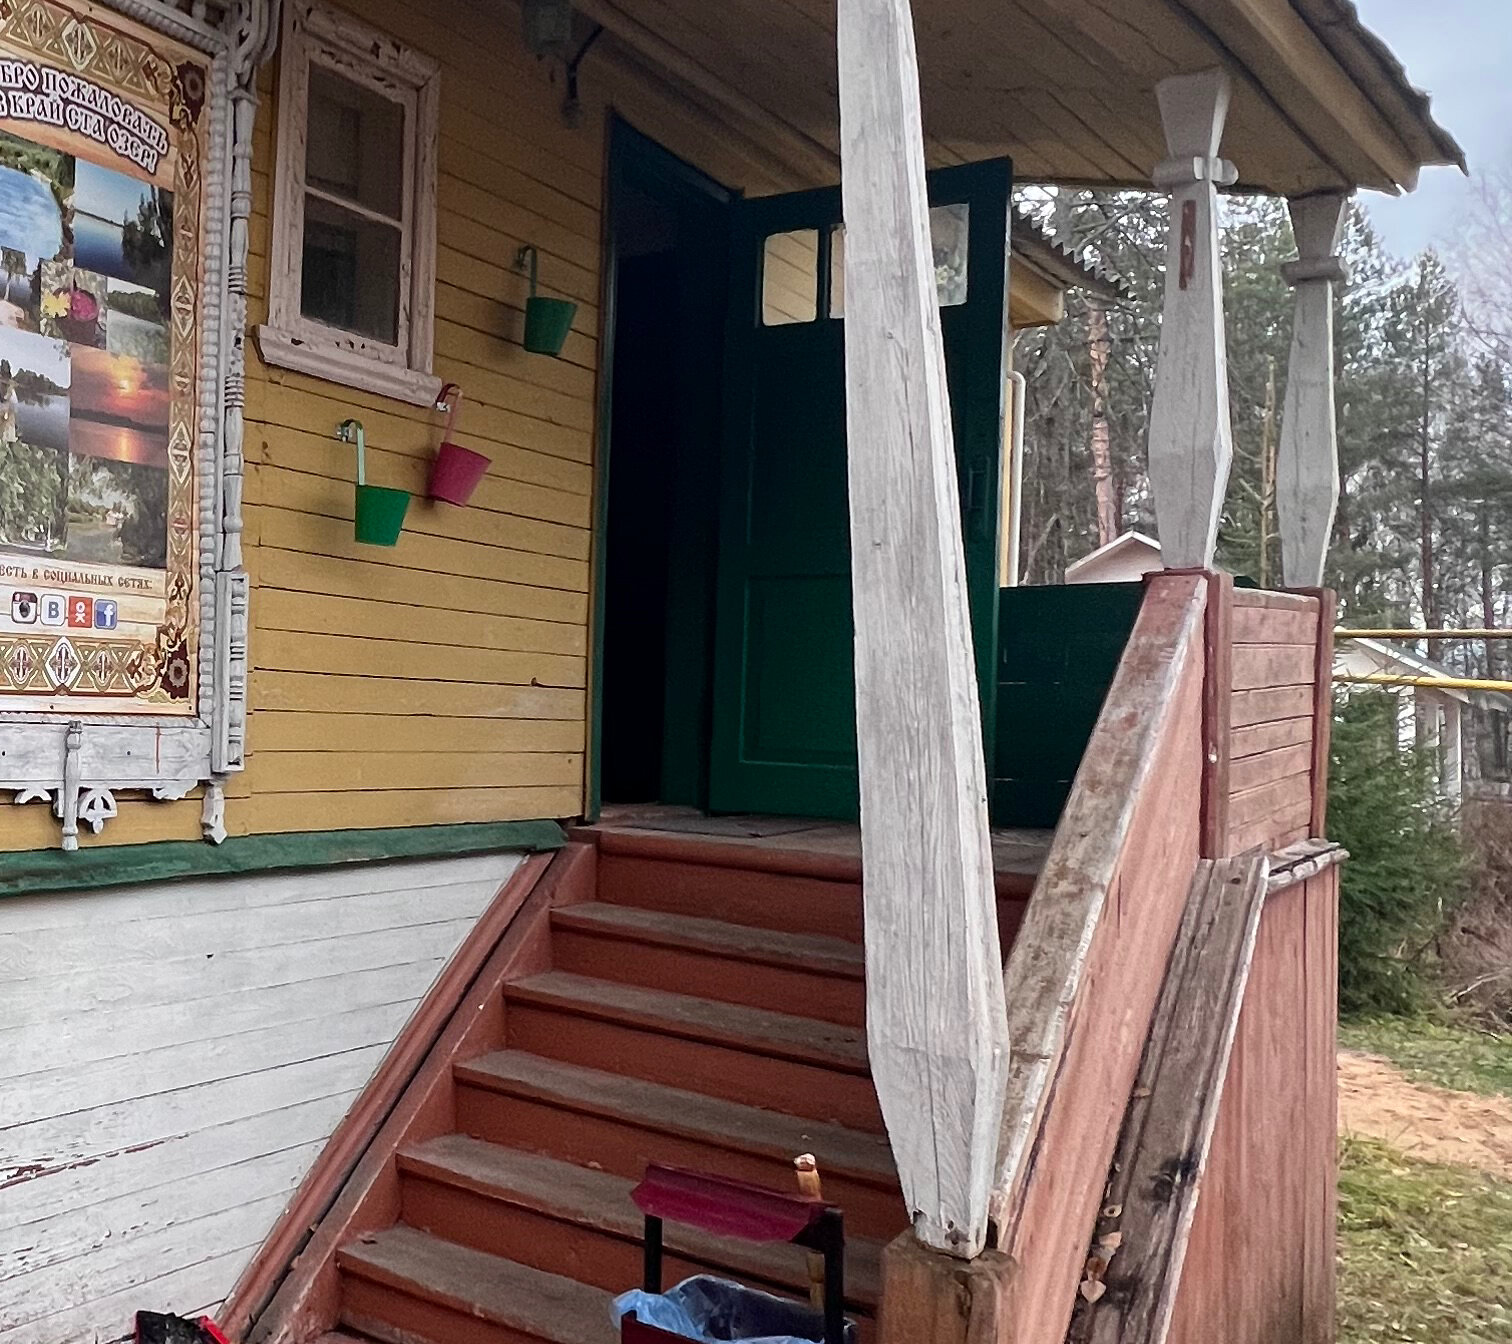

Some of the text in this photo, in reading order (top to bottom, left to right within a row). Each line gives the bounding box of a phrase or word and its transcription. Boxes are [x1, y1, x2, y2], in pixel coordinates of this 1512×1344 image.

[11, 93, 64, 124] КРАЙ
[67, 105, 105, 141] СТА
[42, 69, 168, 154] ПОЖАЛОВАТЬ
[44, 570, 113, 586] социальных
